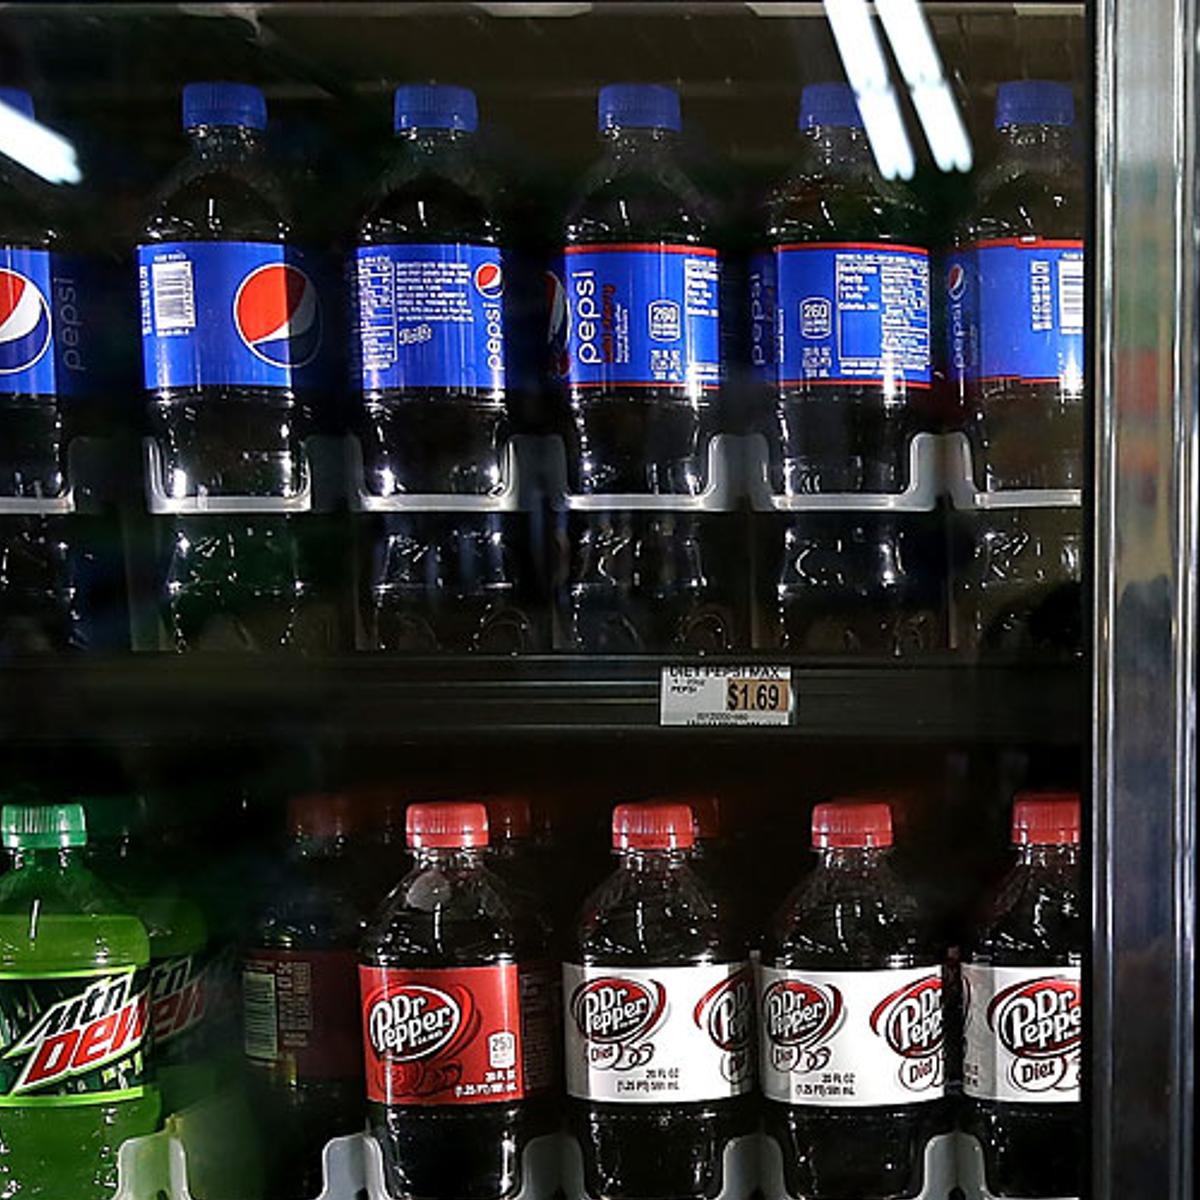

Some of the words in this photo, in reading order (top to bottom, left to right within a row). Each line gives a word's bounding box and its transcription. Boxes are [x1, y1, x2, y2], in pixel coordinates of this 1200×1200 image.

[53, 277, 87, 371] pepsi
[572, 271, 602, 364] pepsi
[804, 304, 827, 318] 260
[483, 302, 506, 371] pepsi
[727, 683, 779, 711] $1.69
[392, 995, 427, 1025] Dr
[584, 991, 648, 1036] Pepper
[599, 987, 628, 1011] Dr
[769, 995, 824, 1037] Pepper
[1035, 988, 1074, 1020] Dr
[375, 1001, 451, 1053] Pepper
[1011, 997, 1082, 1051] Peppe
[1021, 1060, 1055, 1084] Diet
